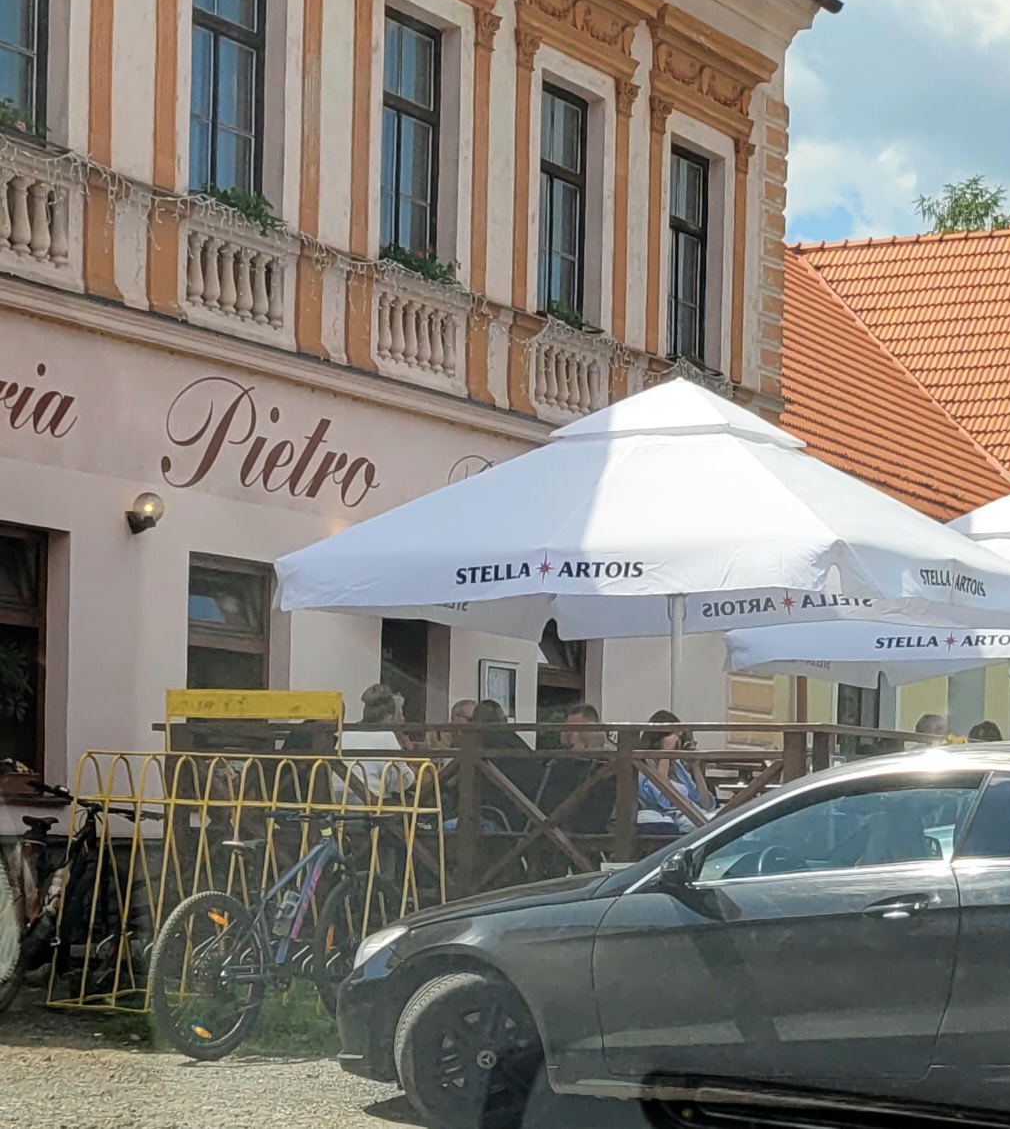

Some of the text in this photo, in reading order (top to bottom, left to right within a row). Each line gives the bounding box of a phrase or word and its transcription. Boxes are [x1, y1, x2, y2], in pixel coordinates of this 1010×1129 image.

[161, 376, 380, 507] Pietro
[456, 561, 644, 585] STELLA ARTOIS
[920, 569, 986, 597] STELLA ARTOIS
[874, 636, 939, 649] STELLA
